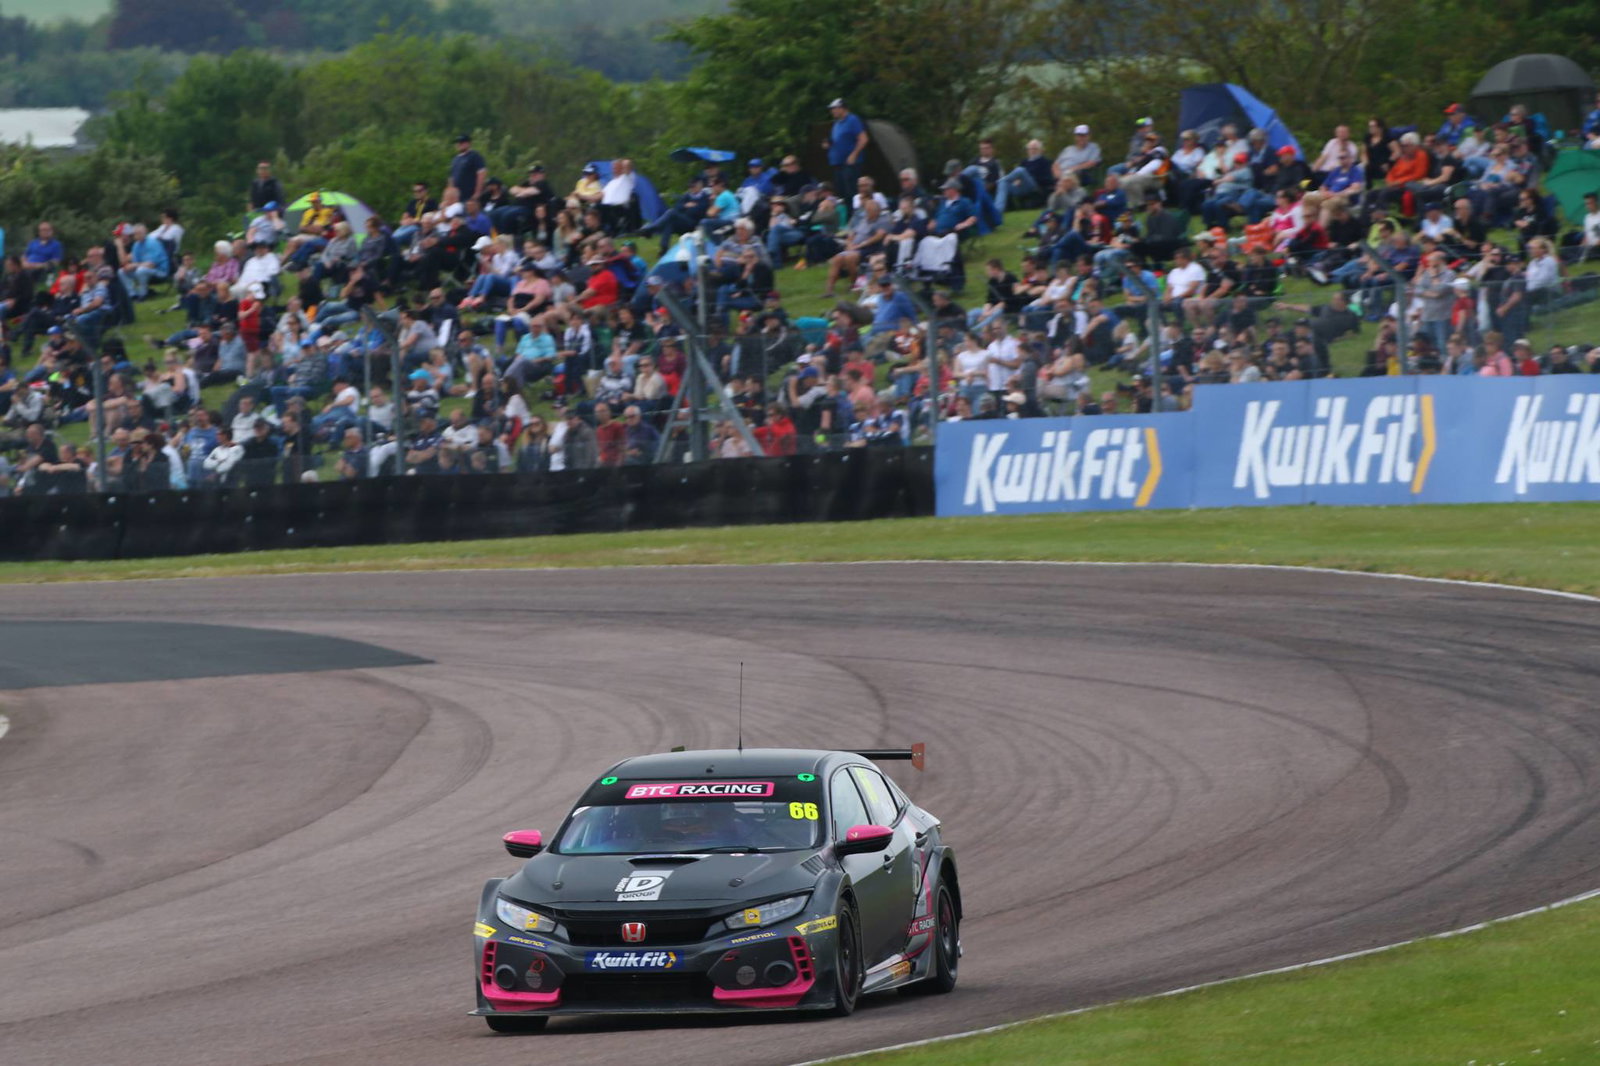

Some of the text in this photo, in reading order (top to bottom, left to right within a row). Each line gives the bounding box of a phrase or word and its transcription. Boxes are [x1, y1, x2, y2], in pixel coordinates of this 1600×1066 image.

[631, 784, 763, 797] BTC RACING
[789, 802, 819, 820] 66
[621, 891, 656, 899] GROUP
[731, 932, 776, 944] RAVENOL
